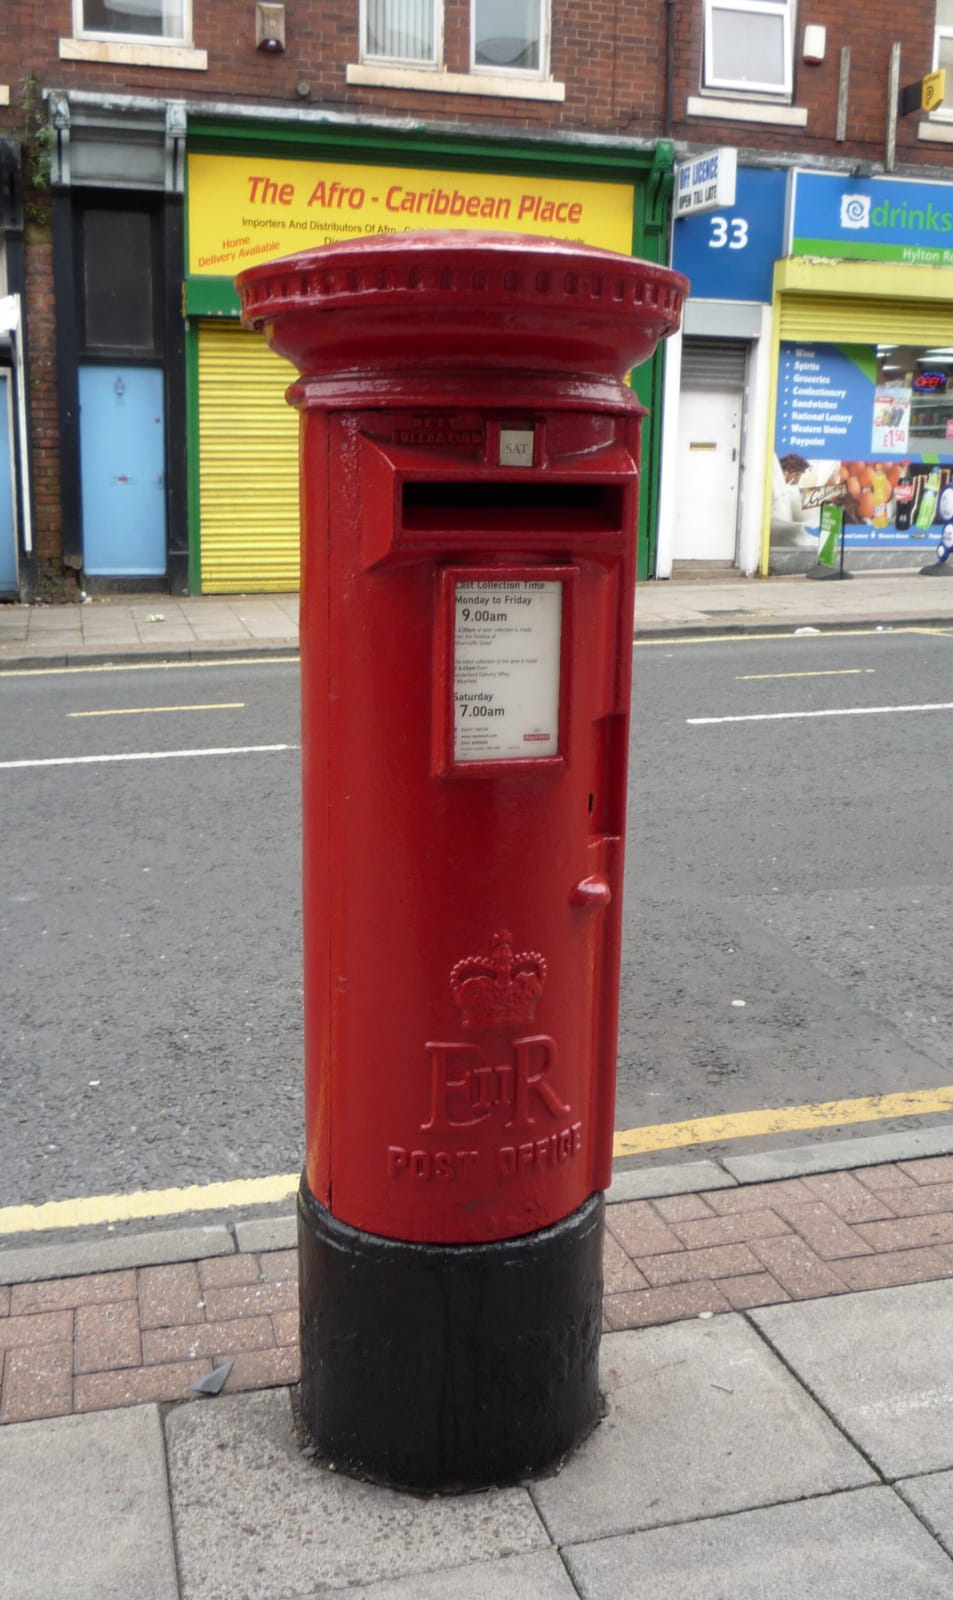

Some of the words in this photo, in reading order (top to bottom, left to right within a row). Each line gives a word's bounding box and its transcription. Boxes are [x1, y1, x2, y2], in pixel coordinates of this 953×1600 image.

[680, 167, 692, 190] OFF
[248, 176, 295, 205] The
[307, 180, 365, 209] Afro
[385, 186, 512, 220] Caribbean
[517, 194, 583, 224] Place
[679, 193, 692, 209] OPEN
[694, 190, 704, 206] TILL
[705, 184, 717, 202] LATE
[242, 216, 287, 230] Importers
[289, 219, 307, 230] And
[310, 220, 363, 234] Distributors
[365, 223, 376, 234] Of
[709, 216, 748, 250] 33
[222, 235, 250, 250] Home
[198, 251, 236, 268] Delivery
[238, 241, 280, 258] Available
[903, 247, 940, 265] Hylton
[794, 361, 820, 372] Spirits
[505, 443, 528, 455] SAT
[456, 581, 474, 590] Last
[478, 581, 521, 590] Collection
[524, 581, 545, 590] Time
[456, 595, 490, 606] Monday
[492, 596, 502, 604] to
[504, 595, 532, 606] Friday
[462, 608, 507, 622] 9.00am
[454, 692, 494, 702] Saturday
[460, 704, 505, 718] 7.00am
[387, 1145, 480, 1180] POST
[499, 1121, 582, 1176] OFFICE
